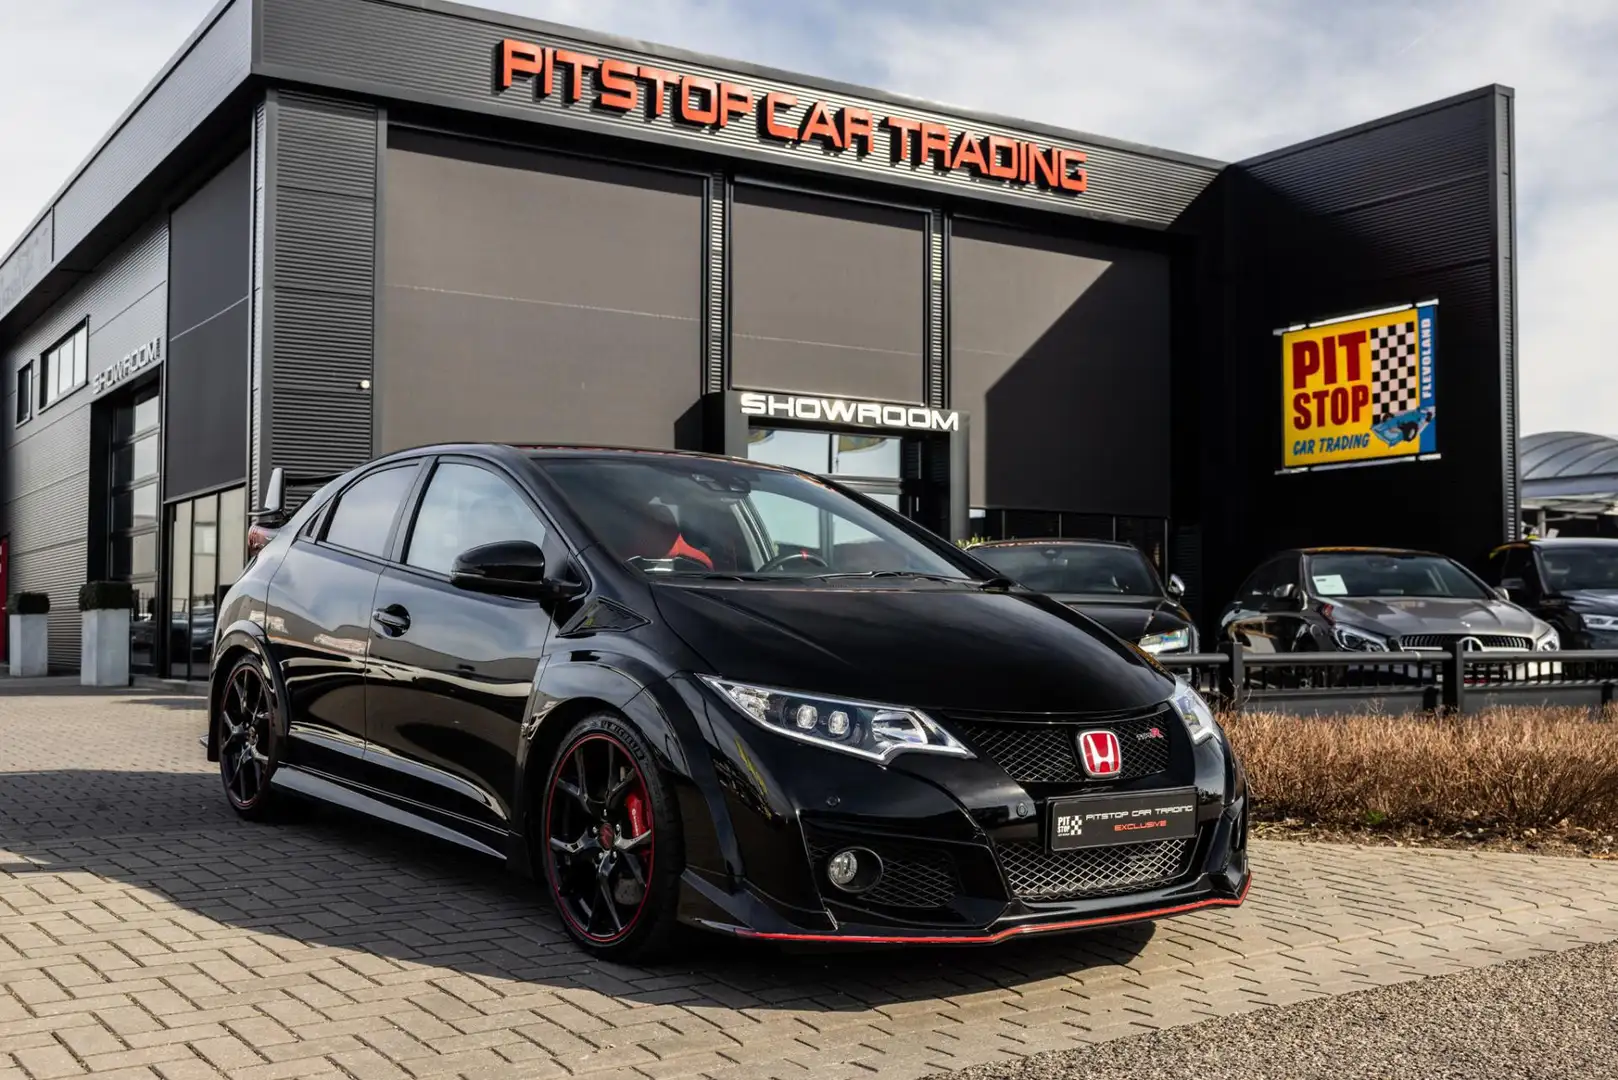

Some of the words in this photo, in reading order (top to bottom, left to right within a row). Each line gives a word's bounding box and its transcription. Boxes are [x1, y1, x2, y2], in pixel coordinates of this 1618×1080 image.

[501, 38, 753, 127] PITSTOP
[765, 92, 874, 153] CAR
[886, 116, 1088, 193] TRADING
[92, 336, 161, 395] SHOWROOM
[1292, 330, 1367, 390] PIT
[1421, 318, 1432, 399] FLEVOLAND
[740, 393, 959, 432] SHOWROOM
[1293, 384, 1369, 431] STOP
[1293, 439, 1316, 456] CAR
[1319, 433, 1370, 453] TRADING
[1057, 816, 1070, 826] PIT
[1057, 825, 1070, 834] STOP
[1085, 811, 1129, 821] PITSTOP
[1132, 809, 1152, 817] CAR
[1155, 805, 1194, 815] TRADING
[1114, 820, 1167, 831] EXCLUSIVE
